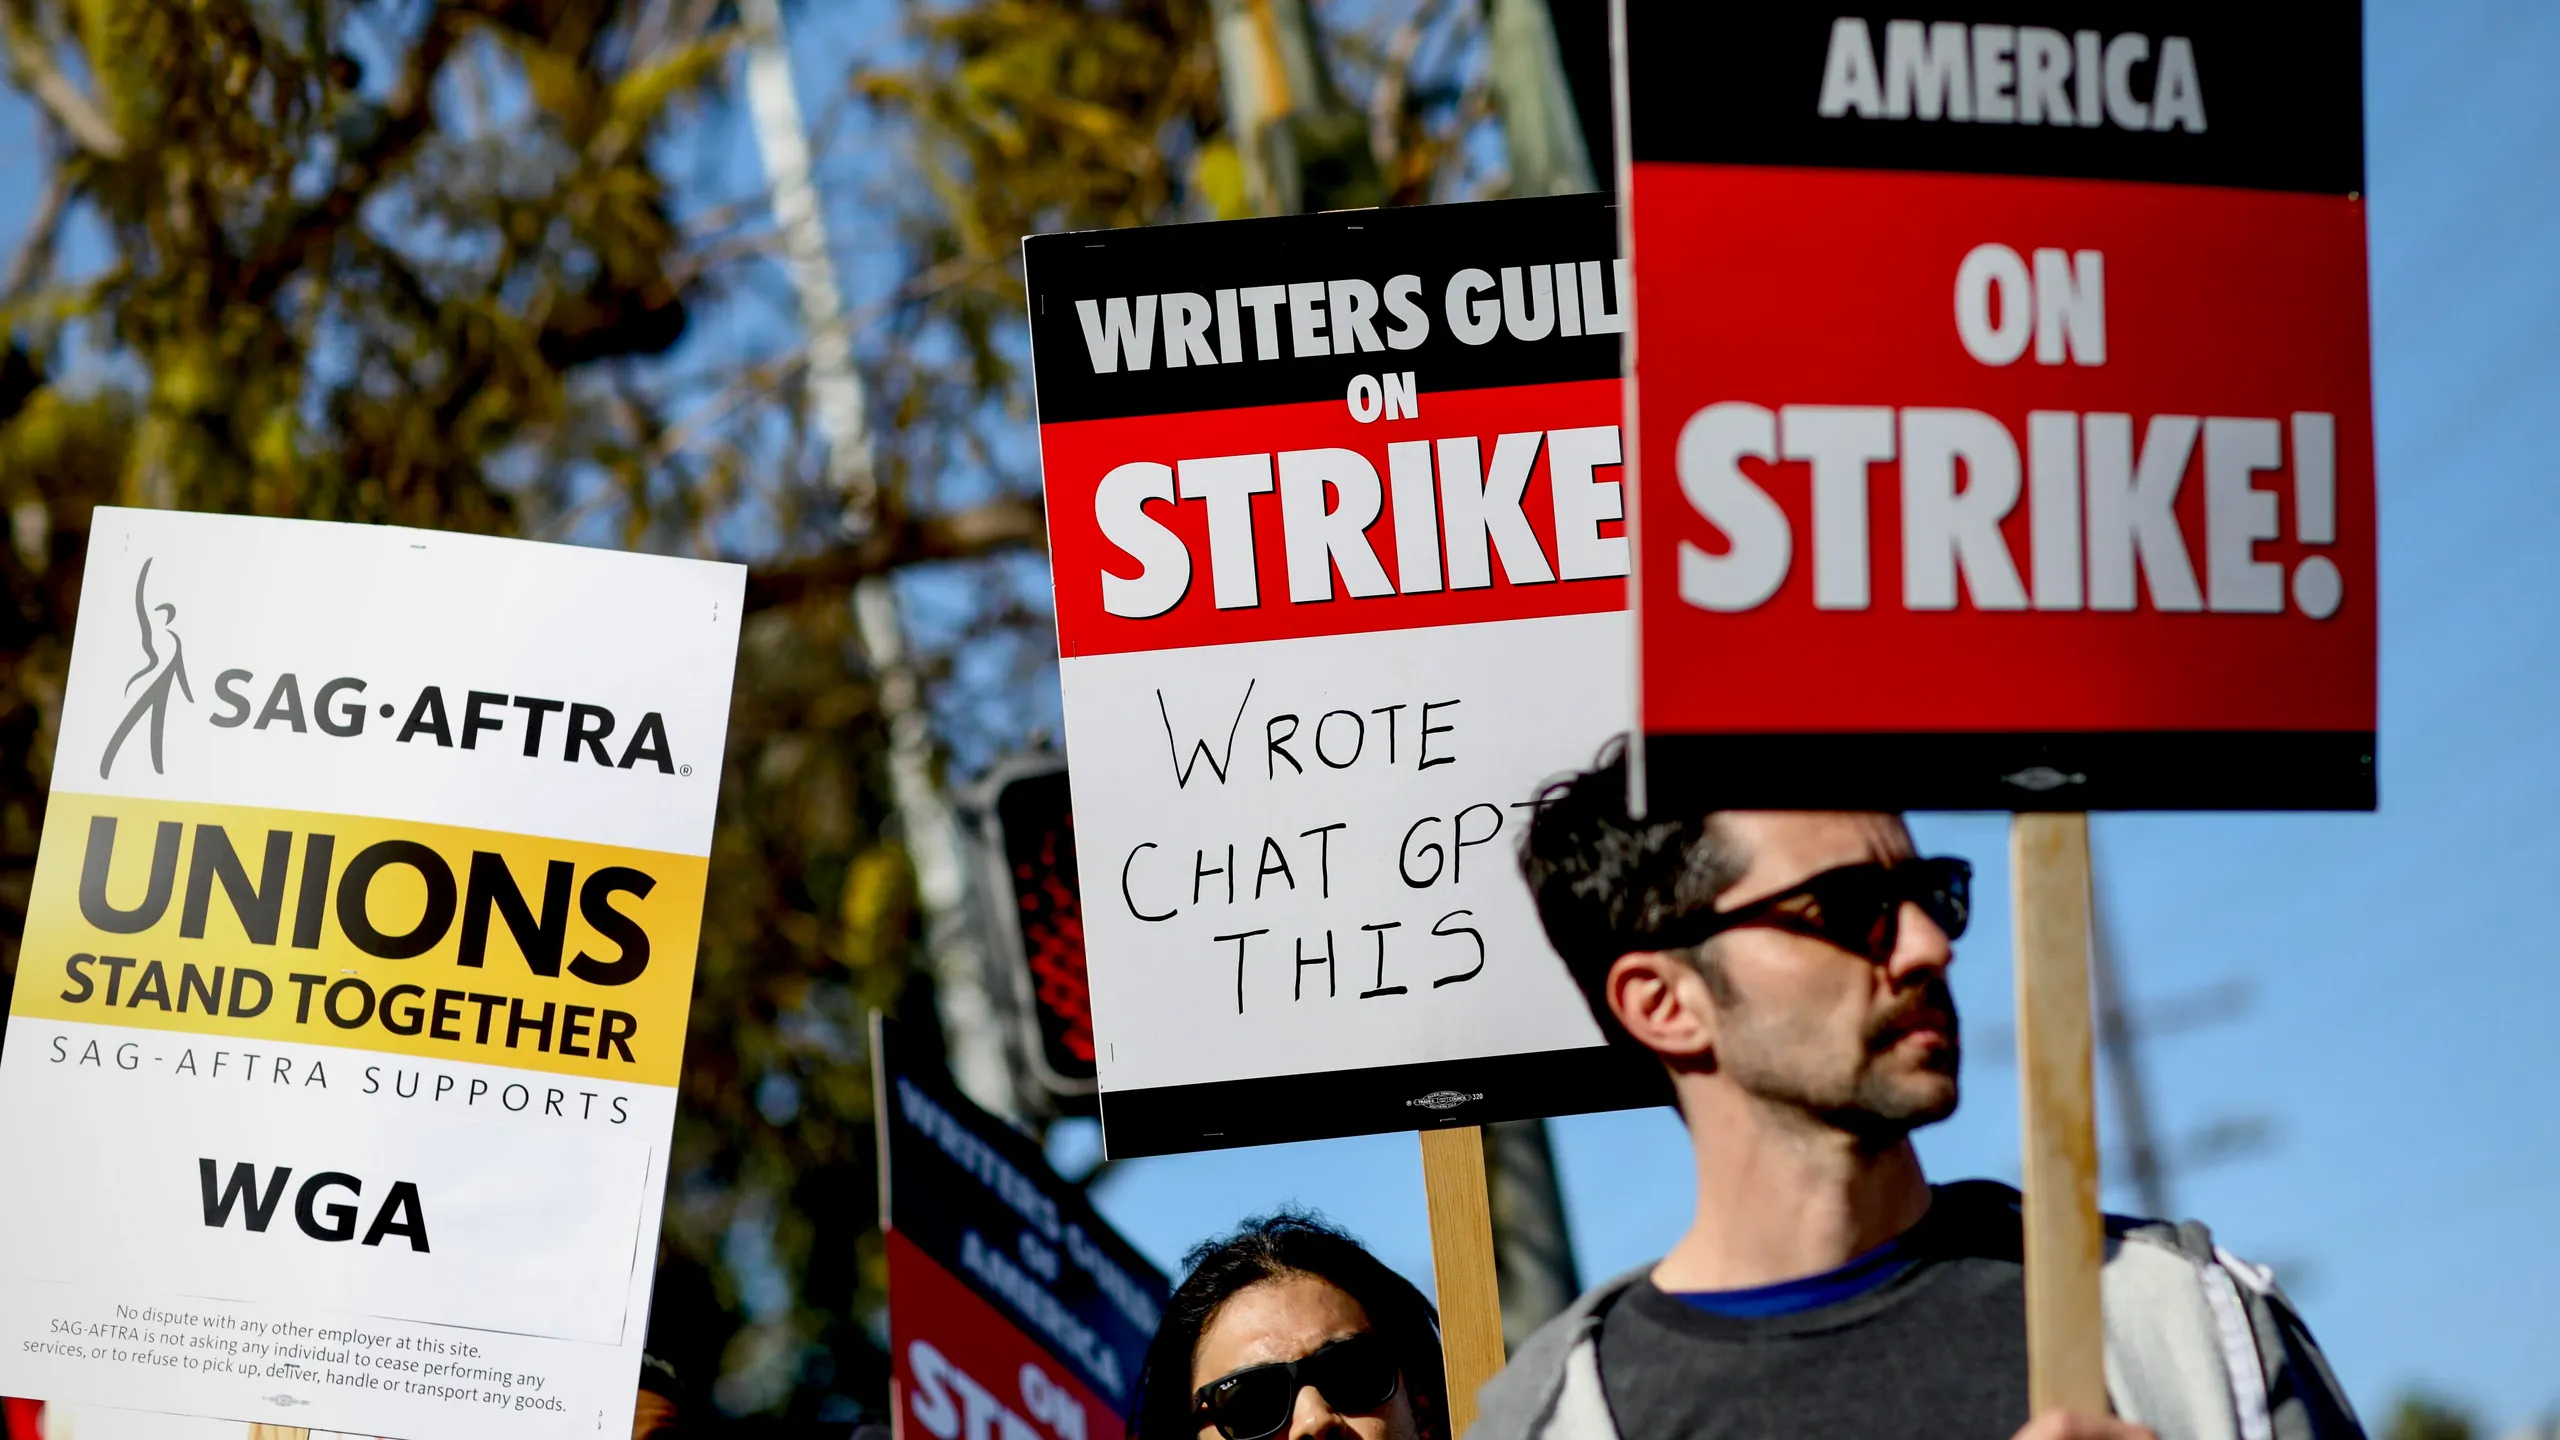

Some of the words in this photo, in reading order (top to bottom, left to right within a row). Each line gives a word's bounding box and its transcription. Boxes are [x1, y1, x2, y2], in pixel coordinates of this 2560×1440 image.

[1819, 18, 2208, 133] AMERICA
[1075, 274, 1430, 374] WRITERS
[1955, 243, 2106, 366] ON
[1346, 371, 1419, 424] ON
[1095, 424, 1630, 620] STRIKE
[1676, 401, 2345, 620] STRIKE!
[1157, 678, 1461, 790] WROTE
[78, 815, 657, 987] UNIONS
[1121, 822, 1347, 922] CHAT
[1398, 800, 1560, 889] GP
[60, 953, 273, 1018] STAND
[287, 972, 638, 1064] TOGETHER
[1213, 909, 1485, 1015] THIS
[50, 1035, 328, 1089] SAG-AFTRA
[362, 1066, 631, 1125] SUPPORTS
[198, 1157, 431, 1253] WGA
[23, 1339, 87, 1359] services,
[91, 1347, 108, 1359] or
[112, 1347, 127, 1362] to
[131, 1349, 178, 1368] refuse
[183, 1355, 199, 1370] to
[202, 1354, 233, 1373] pick
[238, 1364, 261, 1378] up,
[265, 1363, 320, 1384] deliver,
[326, 1369, 379, 1389] handle
[383, 1380, 400, 1392] or
[405, 1379, 478, 1401] transport
[483, 1393, 511, 1408] any
[515, 1396, 567, 1412] goods.
[50, 1318, 139, 1341] SAG-AFTRA
[144, 1327, 155, 1343] is
[160, 1330, 185, 1347] not
[189, 1334, 238, 1356] asking
[242, 1341, 269, 1358] any
[274, 1342, 350, 1365] individual
[355, 1352, 371, 1367] to
[375, 1358, 419, 1373] cease
[424, 1361, 512, 1387] performing
[517, 1376, 545, 1391] any
[116, 1304, 138, 1320] No
[142, 1307, 198, 1327] dispute
[203, 1315, 236, 1331] with
[240, 1321, 265, 1337] any
[271, 1323, 314, 1339] other
[318, 1328, 392, 1350] employer
[396, 1337, 411, 1351] at
[416, 1338, 445, 1354] this
[450, 1342, 482, 1359] site.
[1018, 1362, 1088, 1440] ON
